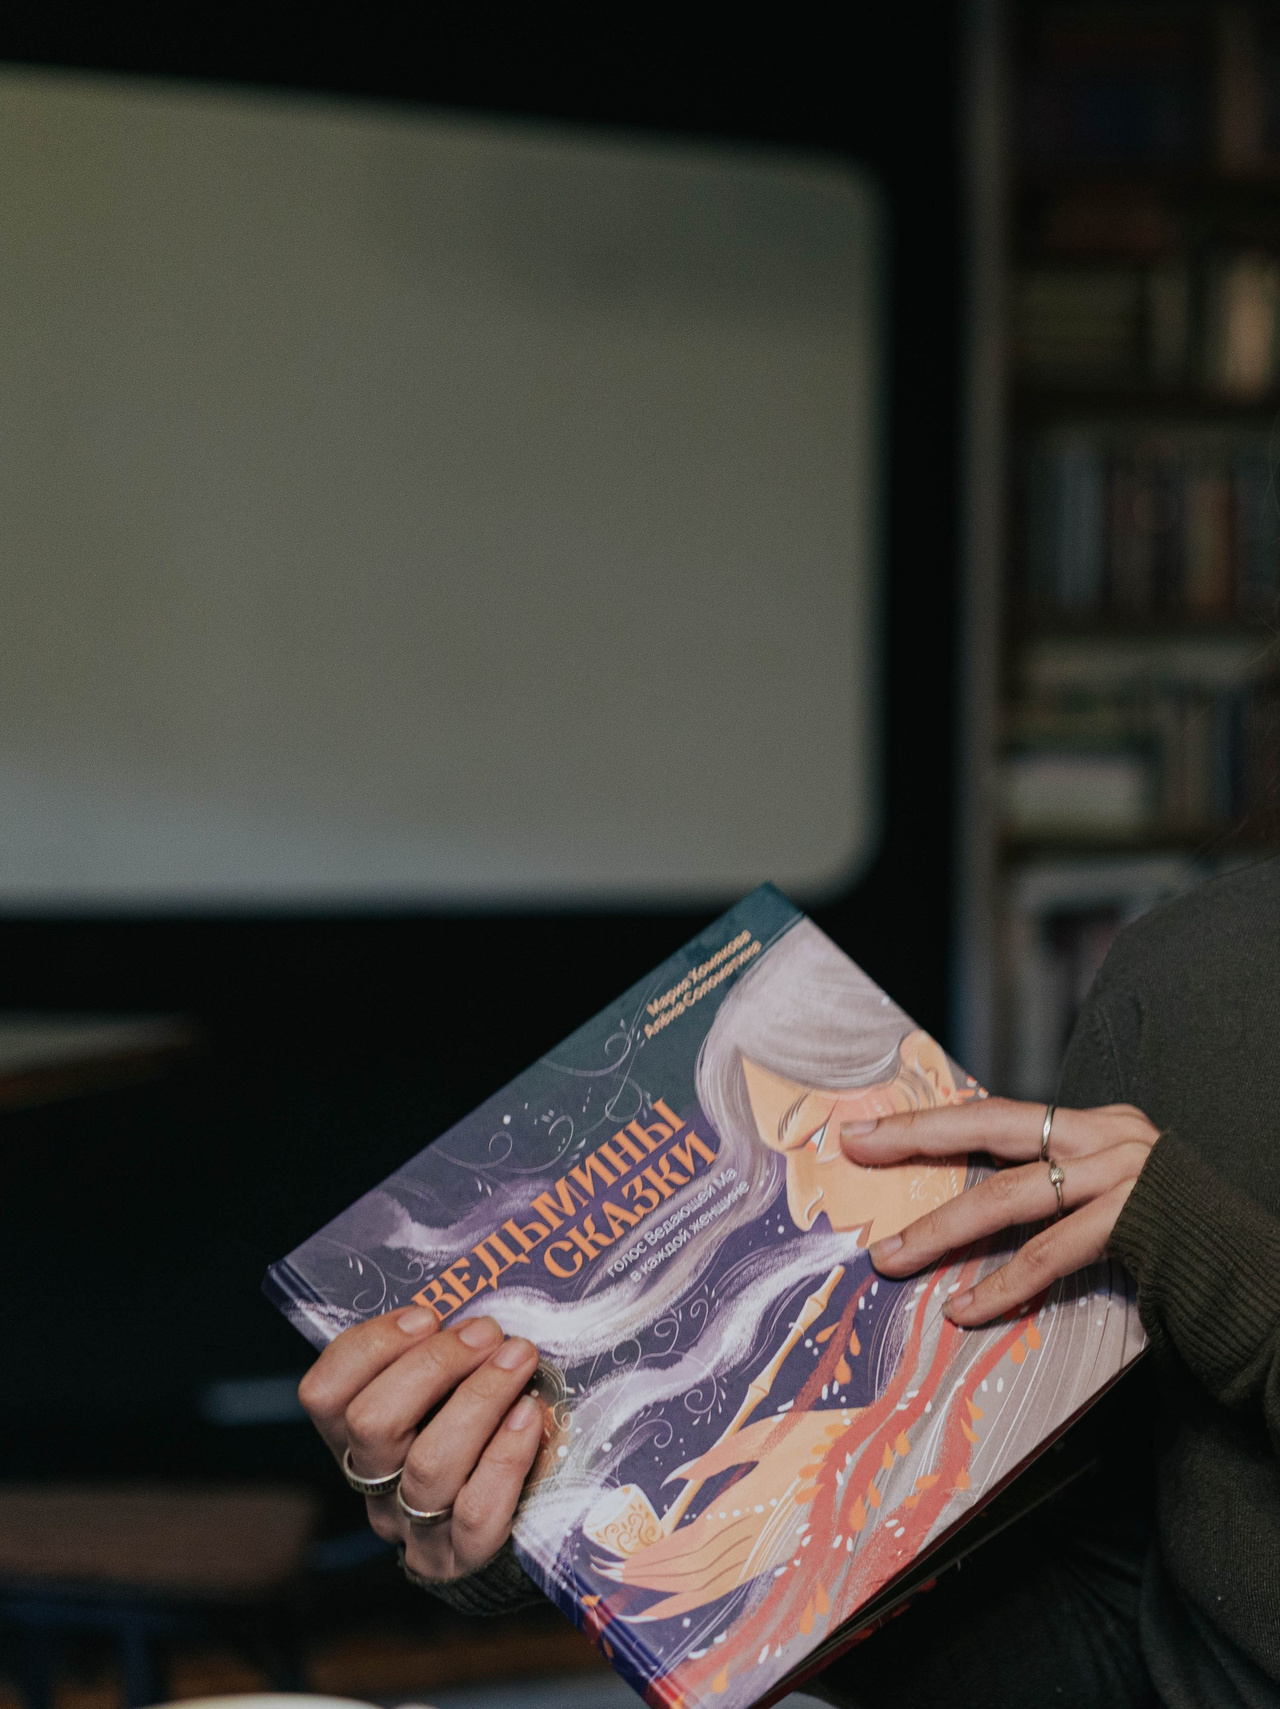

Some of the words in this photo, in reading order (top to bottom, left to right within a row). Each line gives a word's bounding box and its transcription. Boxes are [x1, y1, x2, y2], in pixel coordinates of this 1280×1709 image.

[646, 977, 692, 1017] Мария
[687, 929, 752, 985] Хомякова
[411, 1097, 687, 1321] ВЕДЬМИНЫ
[543, 1130, 719, 1279] СКАЗКИ
[607, 1241, 647, 1278] голос
[644, 1184, 717, 1246] Ведающей
[713, 1168, 738, 1190] Ма
[630, 1270, 641, 1282] в
[640, 1228, 691, 1275] каждой
[689, 1181, 750, 1235] женщине
